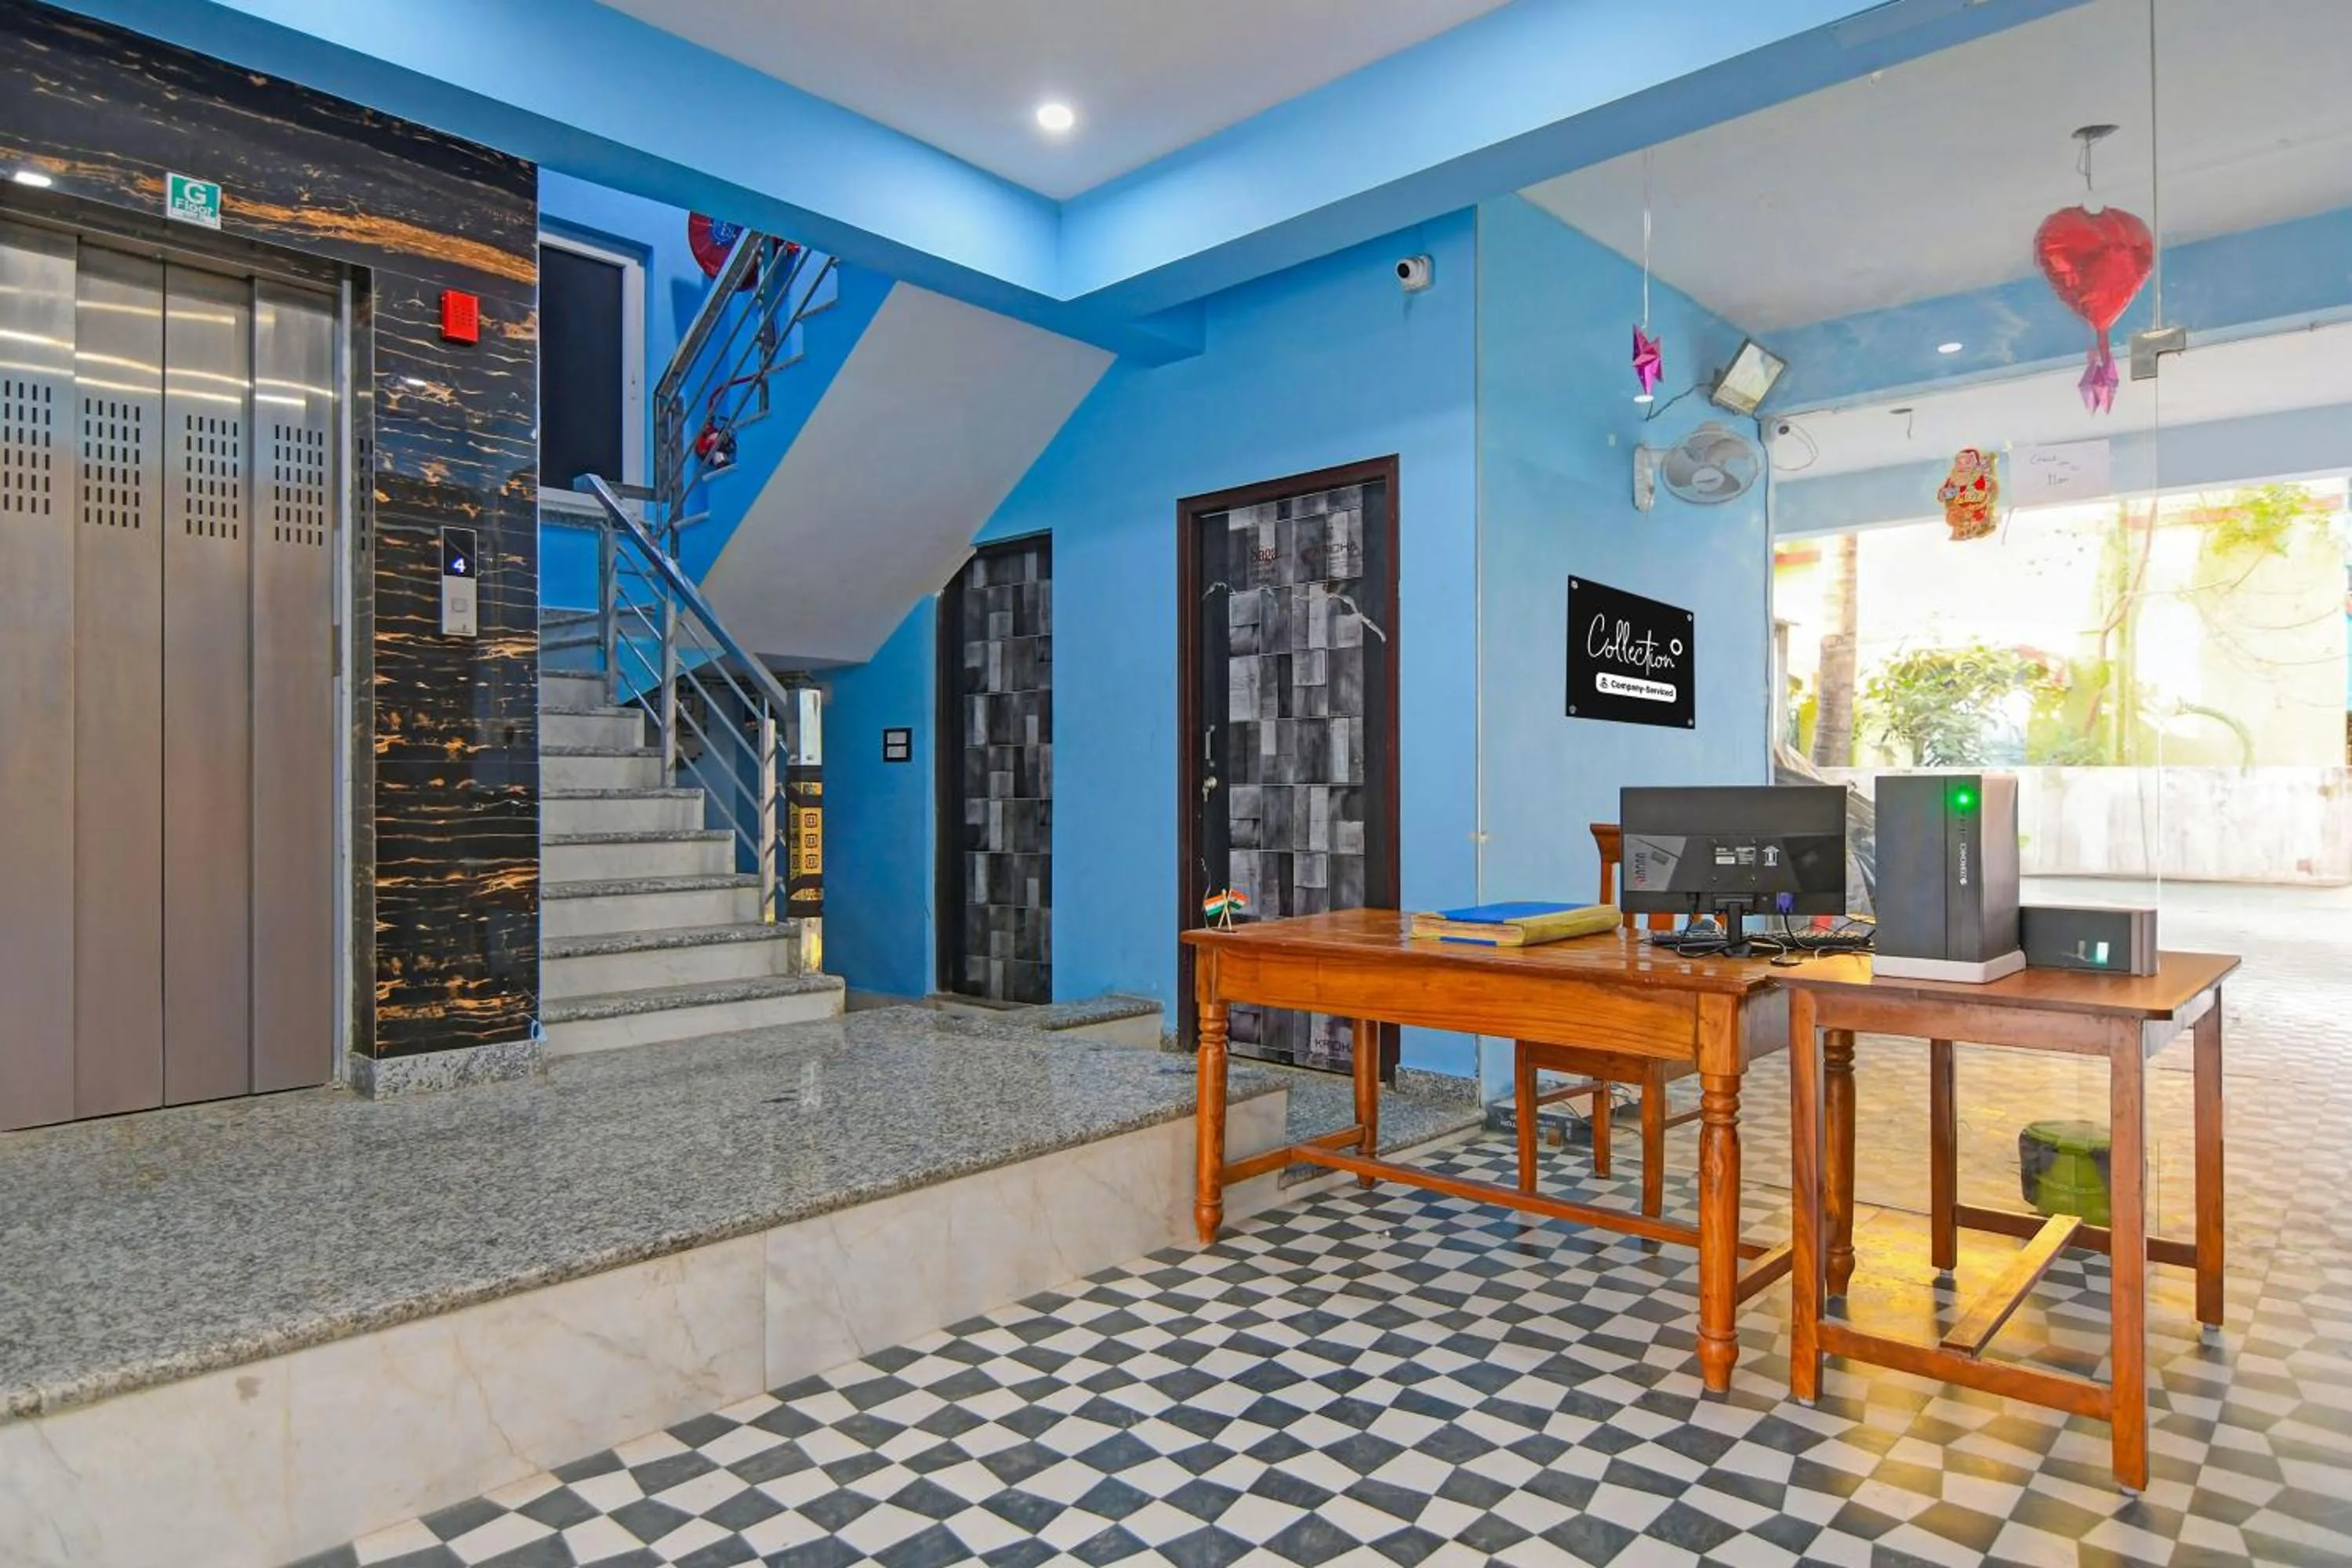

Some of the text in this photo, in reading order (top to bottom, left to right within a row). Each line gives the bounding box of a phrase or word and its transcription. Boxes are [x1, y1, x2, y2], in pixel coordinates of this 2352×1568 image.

[183, 182, 206, 205] G
[175, 197, 214, 216] Floor
[453, 557, 466, 573] 4
[1587, 613, 1675, 676] Collection
[1610, 680, 1674, 697] Company-Serviced
